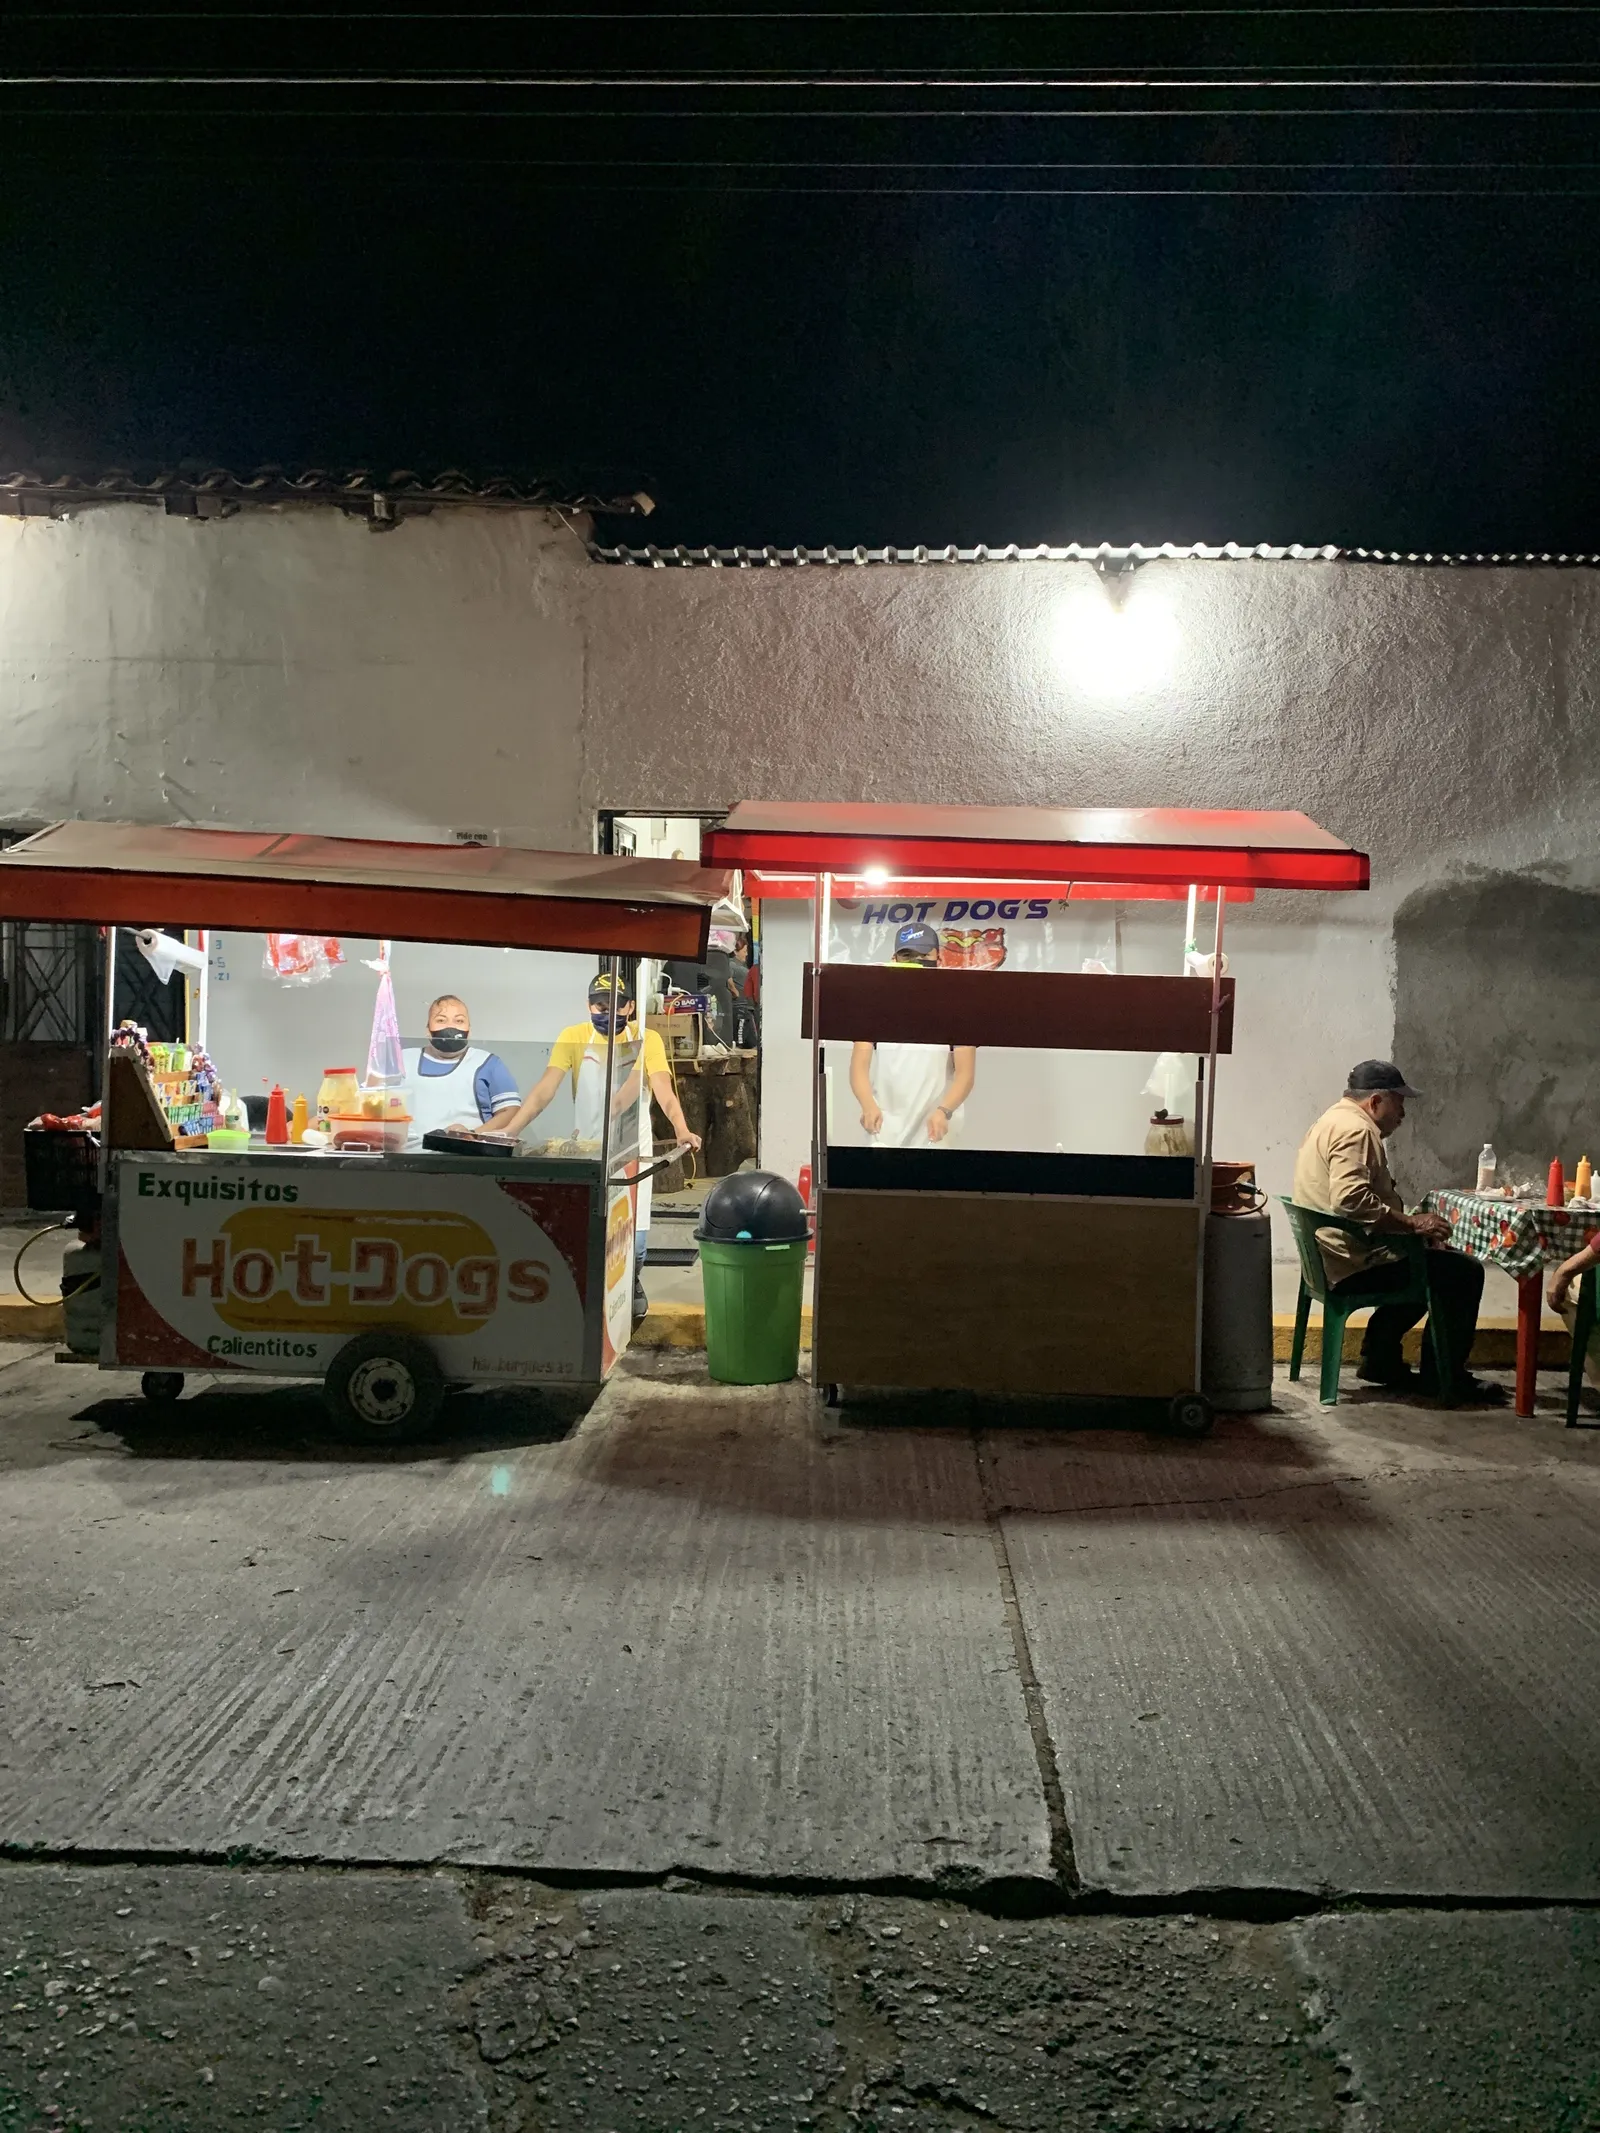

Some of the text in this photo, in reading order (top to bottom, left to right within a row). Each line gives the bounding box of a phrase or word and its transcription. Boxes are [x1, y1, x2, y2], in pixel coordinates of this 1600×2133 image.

[862, 898, 1053, 924] HOT DOG'S
[138, 1172, 299, 1206] Exquisitos
[206, 1334, 318, 1358] Calientitos
